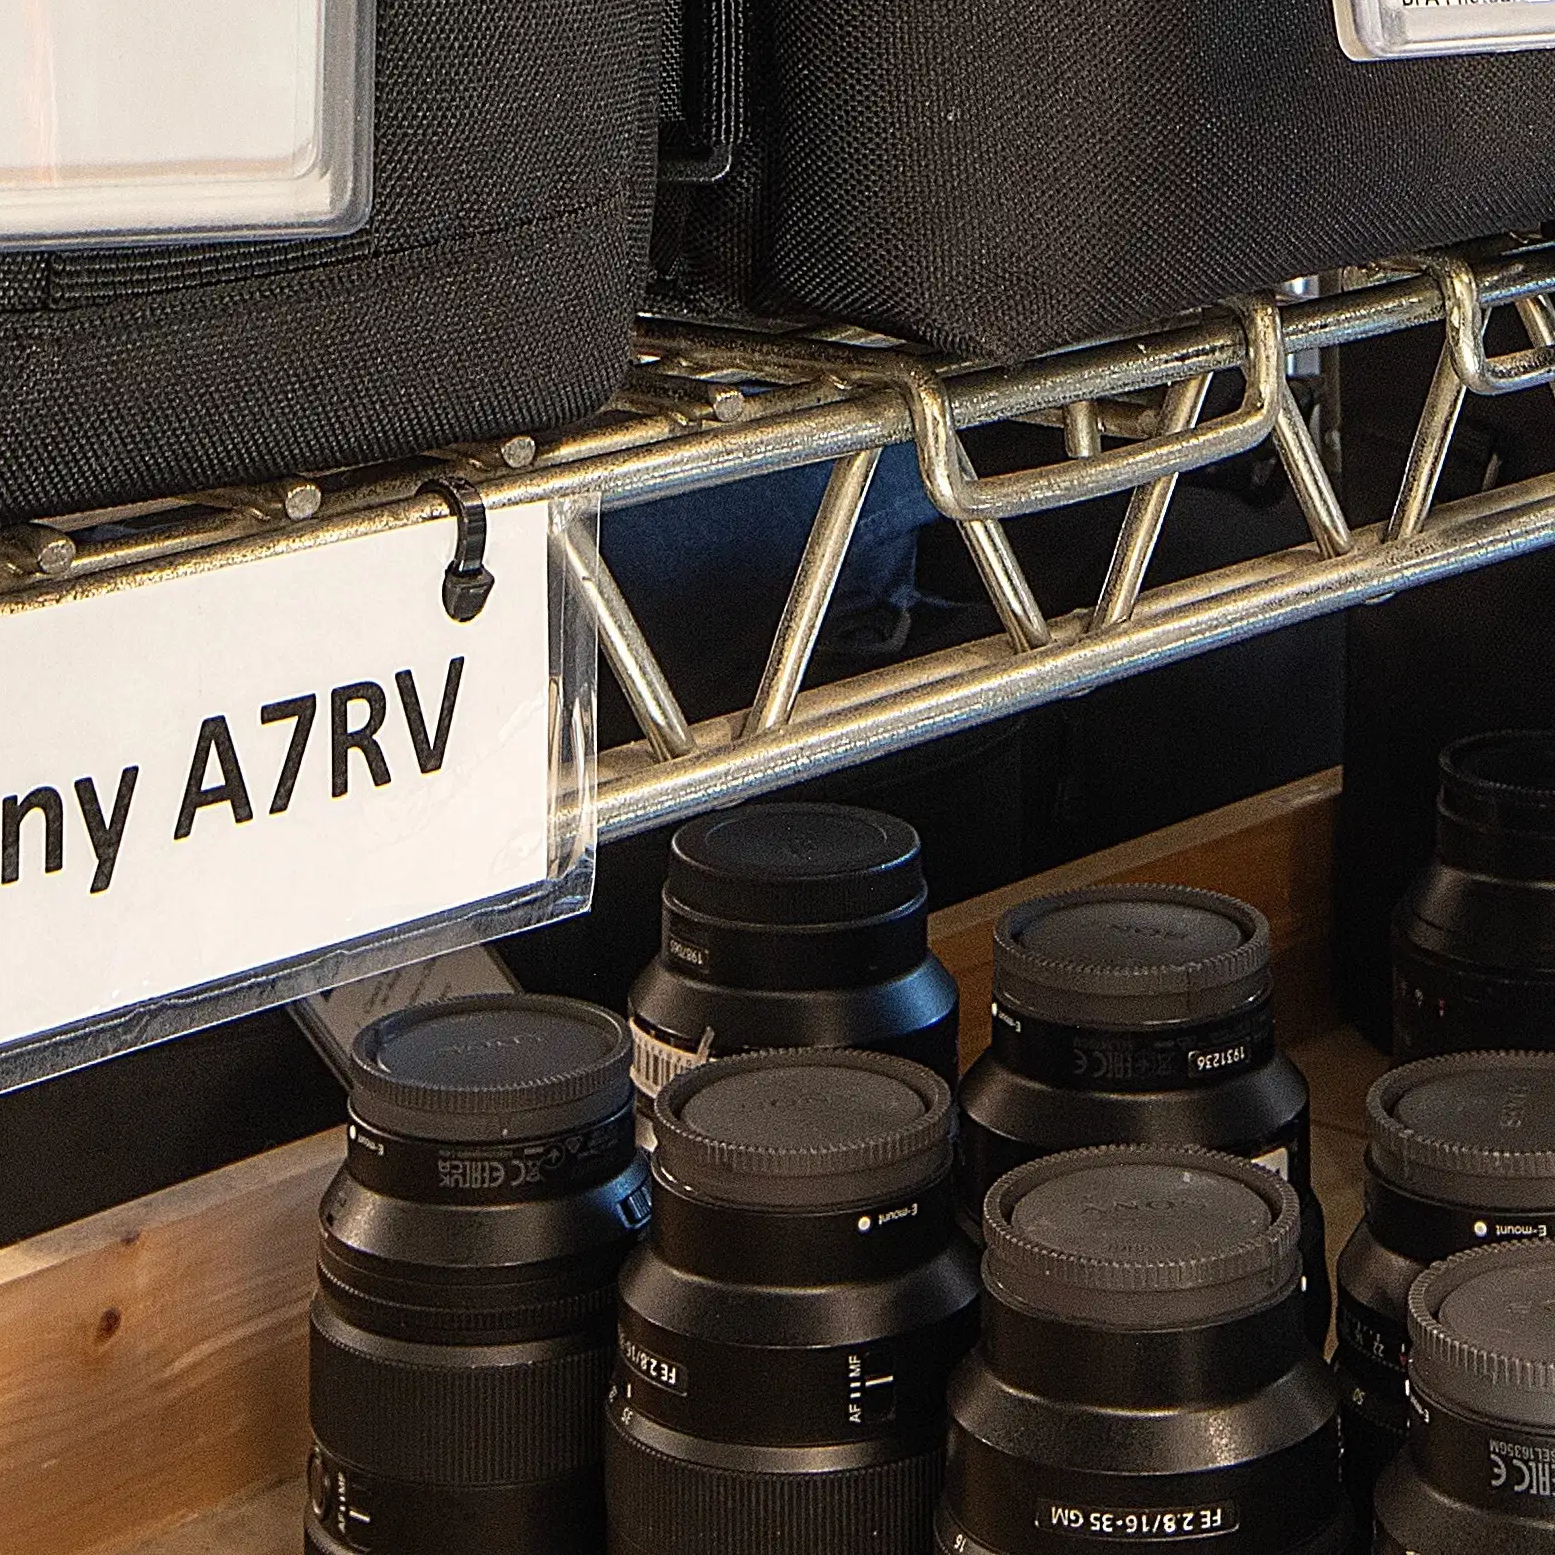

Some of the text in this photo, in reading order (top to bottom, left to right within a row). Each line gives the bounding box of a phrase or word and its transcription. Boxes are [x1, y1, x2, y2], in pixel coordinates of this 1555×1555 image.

[173, 655, 465, 840] A7RV
[1197, 1046, 1245, 1071] 1931236
[1495, 1224, 1548, 1239] E-mount
[658, 1363, 677, 1385] FE
[1051, 1506, 1223, 1534] FE 2.8/16-35 GM
